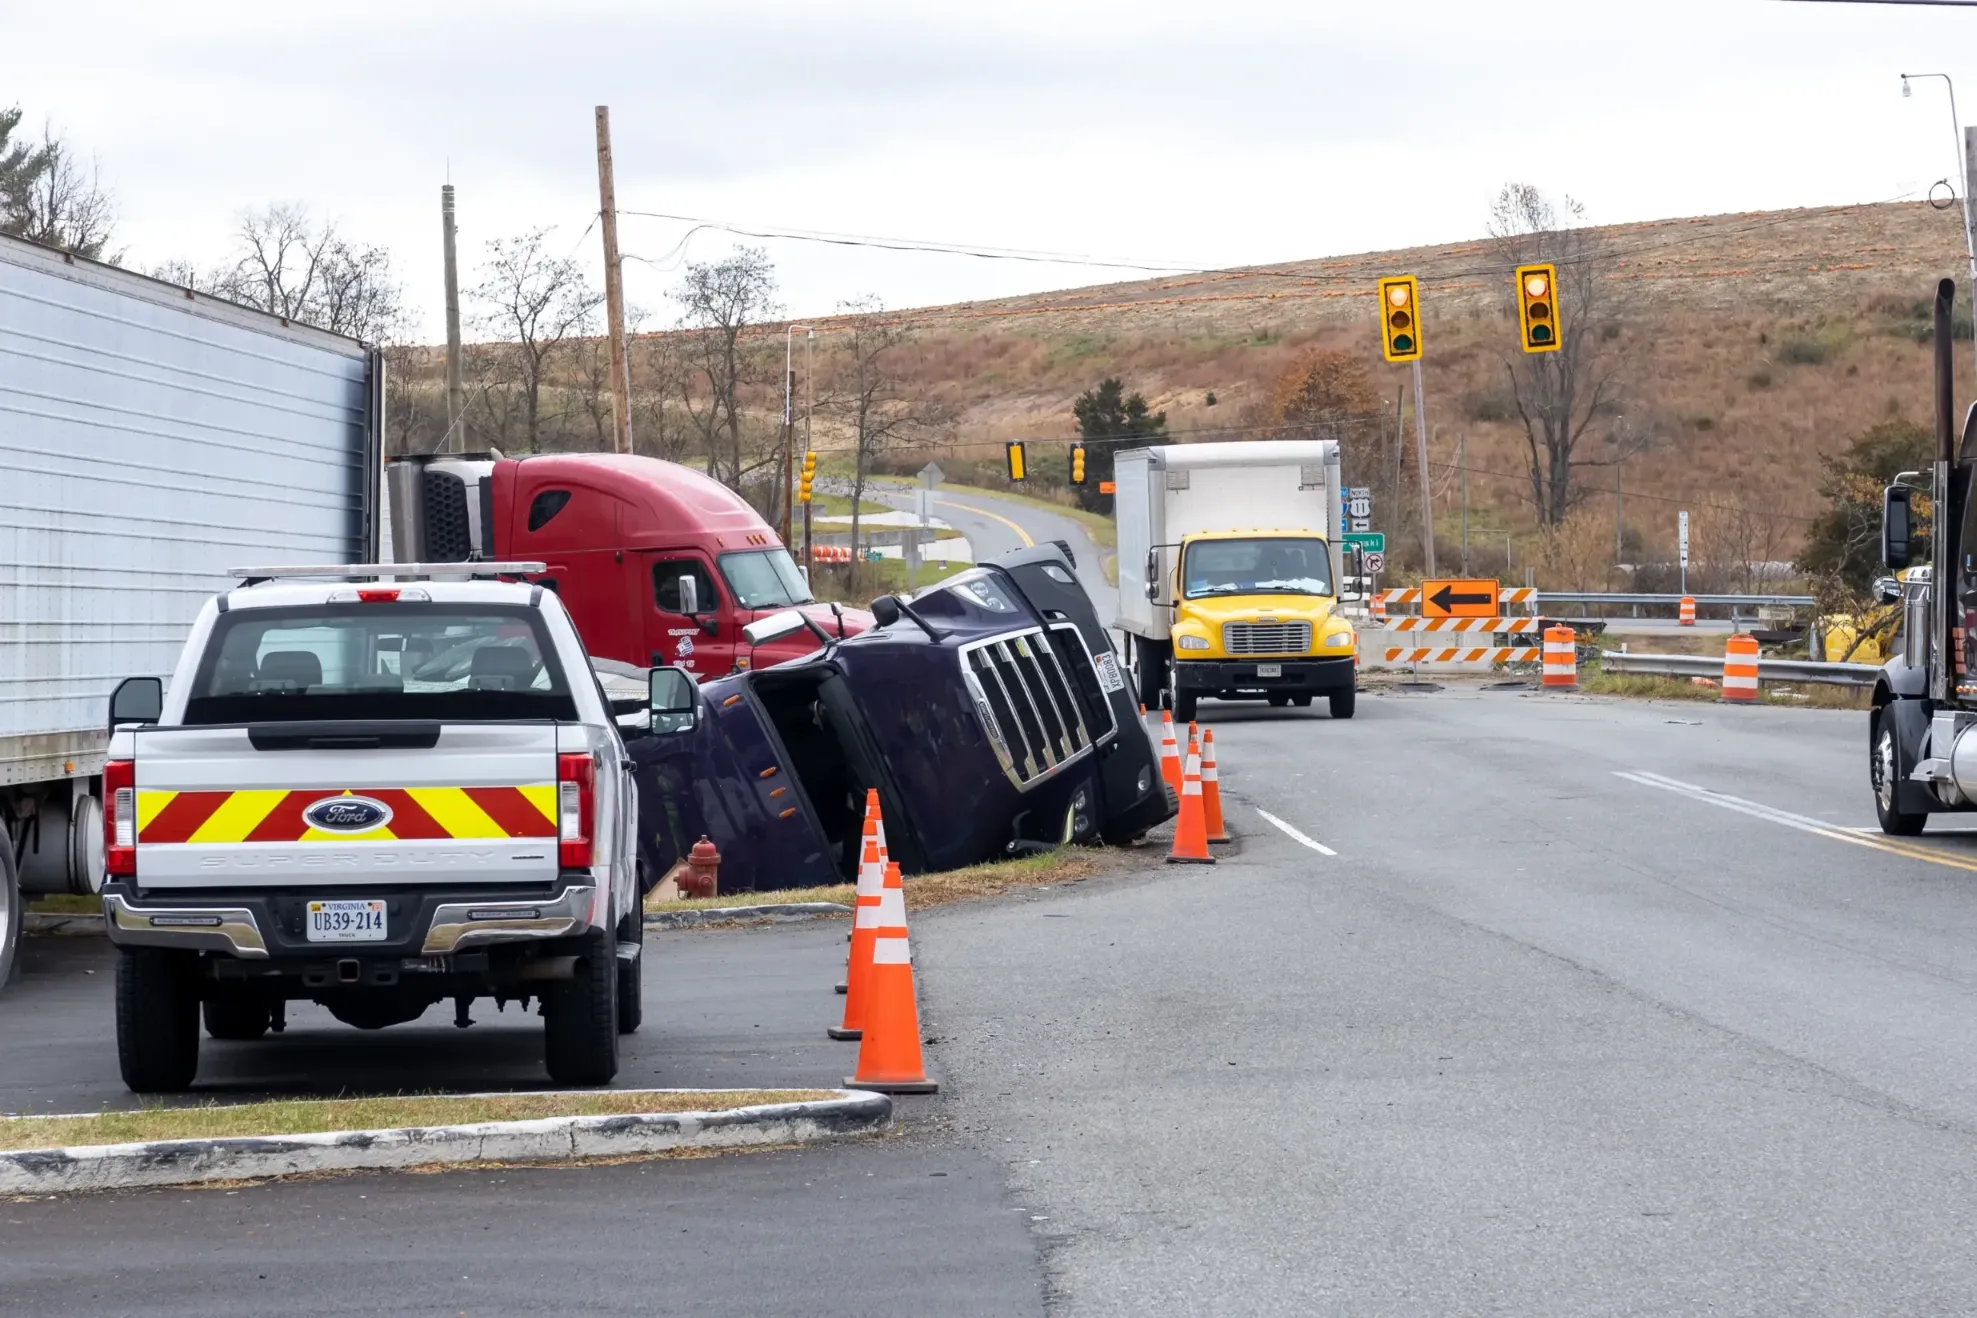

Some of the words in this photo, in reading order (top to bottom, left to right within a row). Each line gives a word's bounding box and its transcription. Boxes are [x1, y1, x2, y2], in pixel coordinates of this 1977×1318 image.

[1355, 502, 1365, 514] 11
[325, 804, 368, 823] Ford
[199, 853, 359, 868] SUPER
[373, 850, 496, 866] DUTY
[328, 902, 366, 911] VIRGINIA
[314, 912, 383, 931] UB39-214
